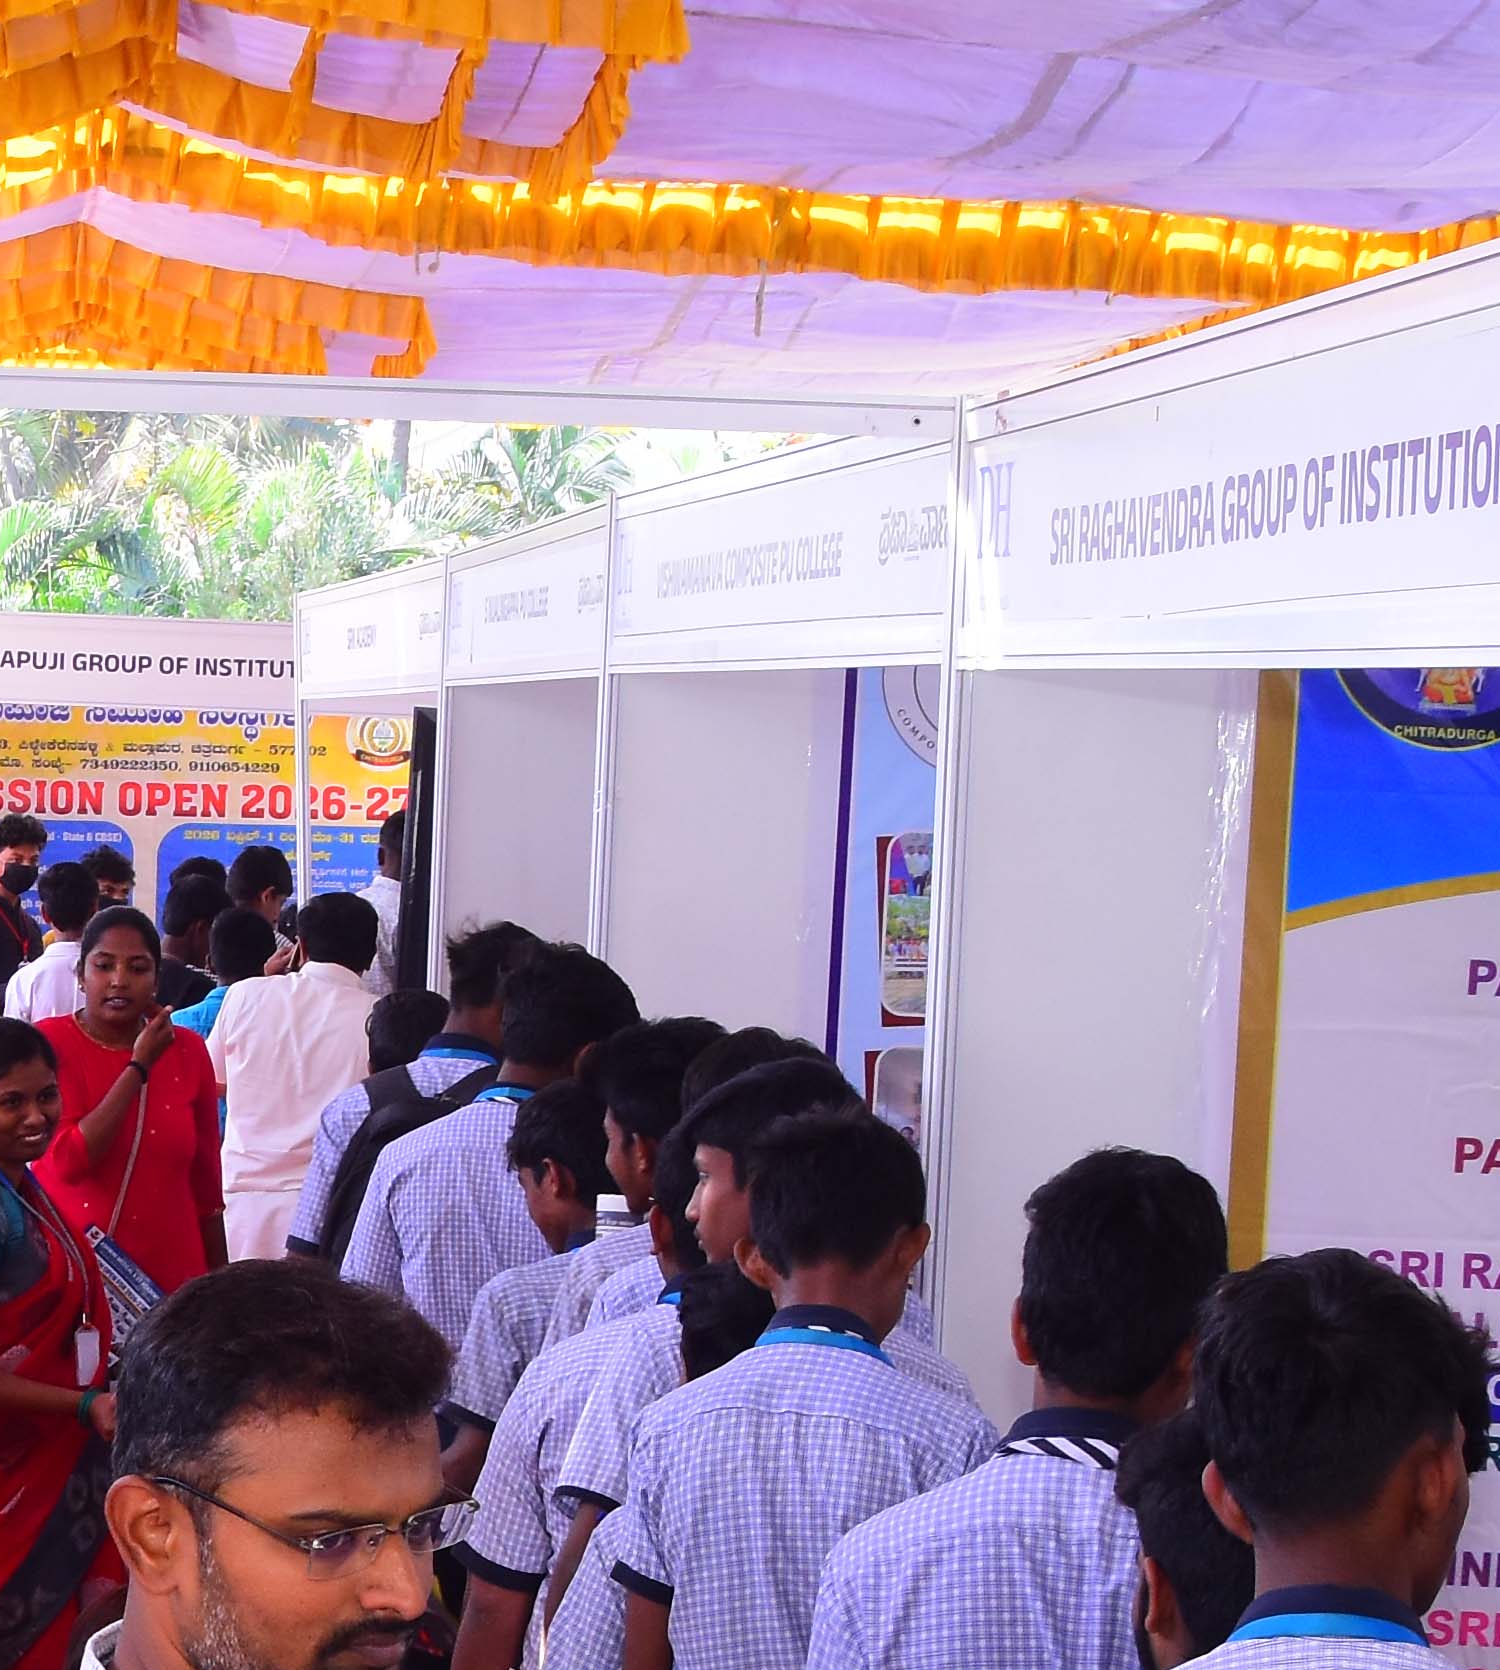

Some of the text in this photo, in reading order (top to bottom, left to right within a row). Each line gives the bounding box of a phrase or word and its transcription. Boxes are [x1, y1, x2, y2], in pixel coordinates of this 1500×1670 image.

[1049, 505, 1076, 567] SRI
[1079, 482, 1217, 563] RAGHAVENDRA
[1221, 462, 1298, 545] GROUP
[1302, 454, 1335, 526] OF
[796, 531, 844, 579] COLLEGE
[73, 653, 152, 674] GROUP
[159, 657, 189, 675] OF
[1394, 724, 1497, 743] CHITRADURGA
[79, 759, 280, 774] 7349222350, 9110654229
[118, 782, 229, 817] OPEN
